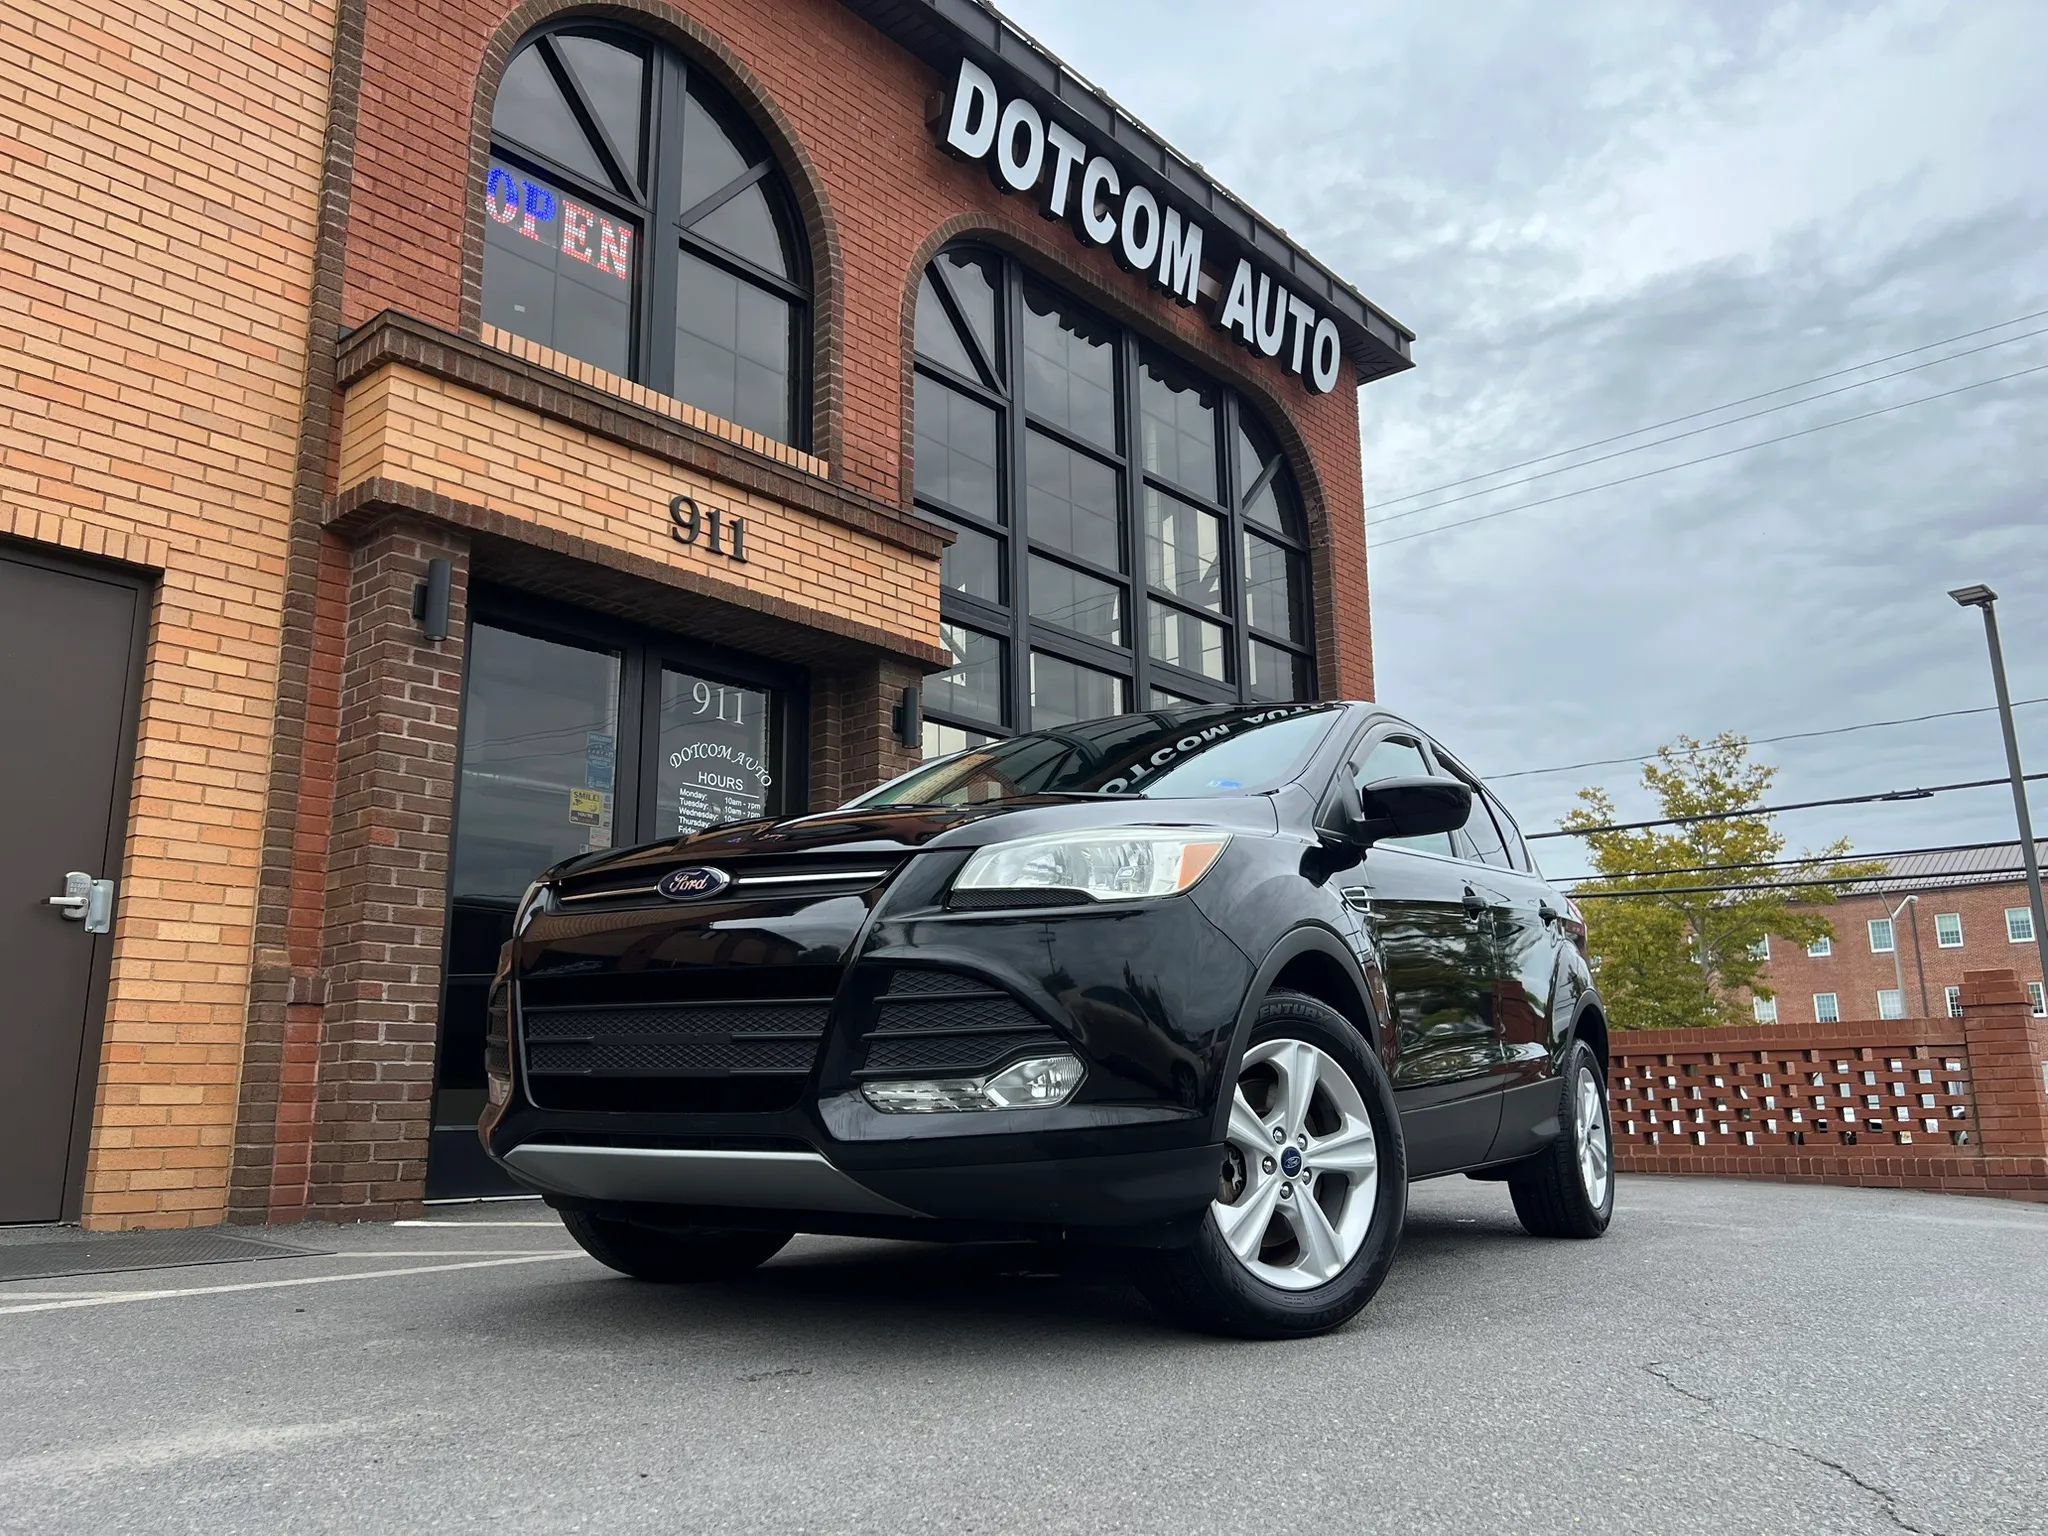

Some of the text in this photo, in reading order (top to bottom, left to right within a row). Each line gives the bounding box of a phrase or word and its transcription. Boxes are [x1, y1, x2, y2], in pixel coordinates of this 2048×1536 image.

[485, 168, 632, 280] OPEN
[947, 57, 1341, 394] DOTCOM AUTO
[669, 495, 748, 564] 911
[692, 682, 744, 725] 911
[669, 742, 772, 786] DOTCOM AUTO
[698, 771, 744, 791] HOURS
[680, 788, 707, 801] Monday:
[725, 797, 742, 806] 10am
[748, 802, 761, 810] 7pm
[680, 797, 709, 810] Tuesday:
[725, 806, 742, 816] 10am
[679, 807, 740, 823] Wednesday: 10a
[669, 871, 710, 893] Ford
[1259, 1003, 1332, 1020] ENTURY
